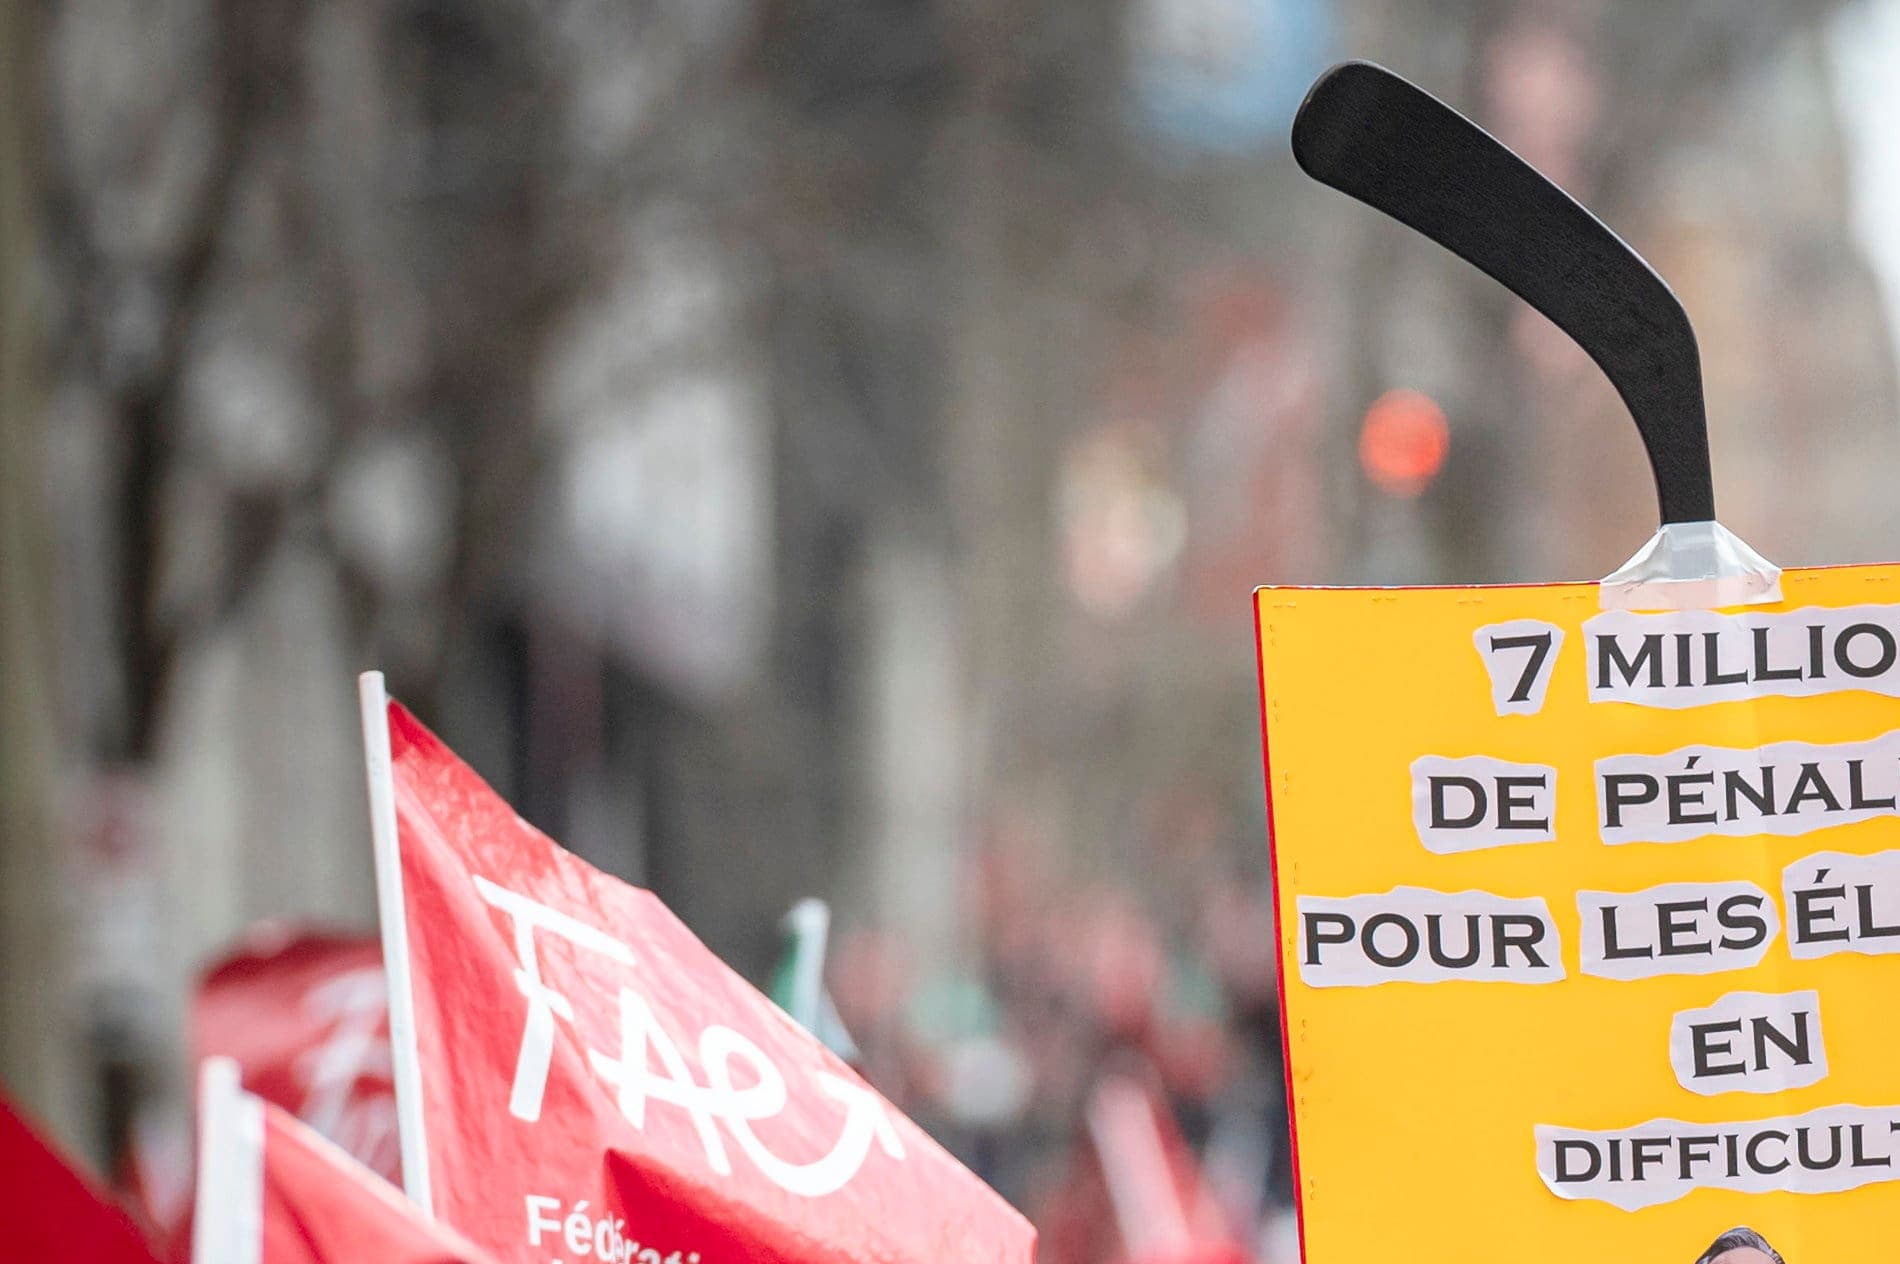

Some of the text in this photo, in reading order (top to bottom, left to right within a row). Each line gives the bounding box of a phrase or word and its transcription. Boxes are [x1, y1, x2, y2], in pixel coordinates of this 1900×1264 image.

[1490, 631, 1552, 703] 7
[1428, 774, 1549, 832] DE
[1302, 911, 1549, 968] POUR
[1600, 894, 1767, 960] LES
[1689, 1011, 1812, 1078] EN
